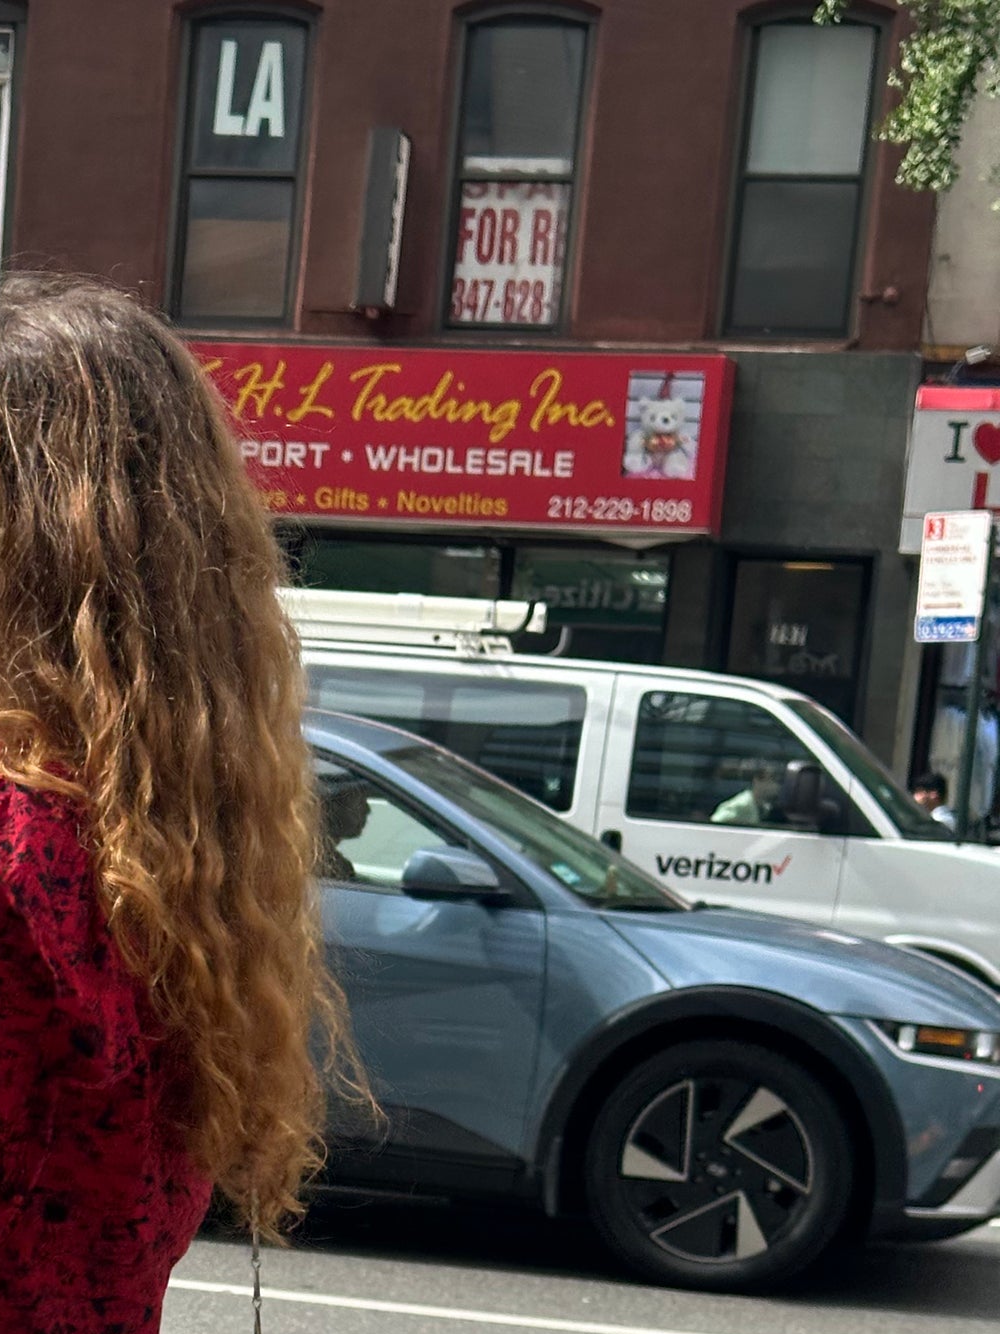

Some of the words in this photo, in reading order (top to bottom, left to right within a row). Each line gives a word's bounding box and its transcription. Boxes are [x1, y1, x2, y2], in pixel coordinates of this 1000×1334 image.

[213, 40, 285, 137] LA
[457, 207, 521, 266] FOR
[350, 362, 521, 443] Trading
[530, 368, 616, 432] Inc.
[365, 443, 575, 478] WHOLESALE
[314, 486, 370, 511] Gifts
[396, 490, 509, 517] Novelties
[547, 495, 693, 522] 212-229-1898
[655, 852, 773, 884] verizon
